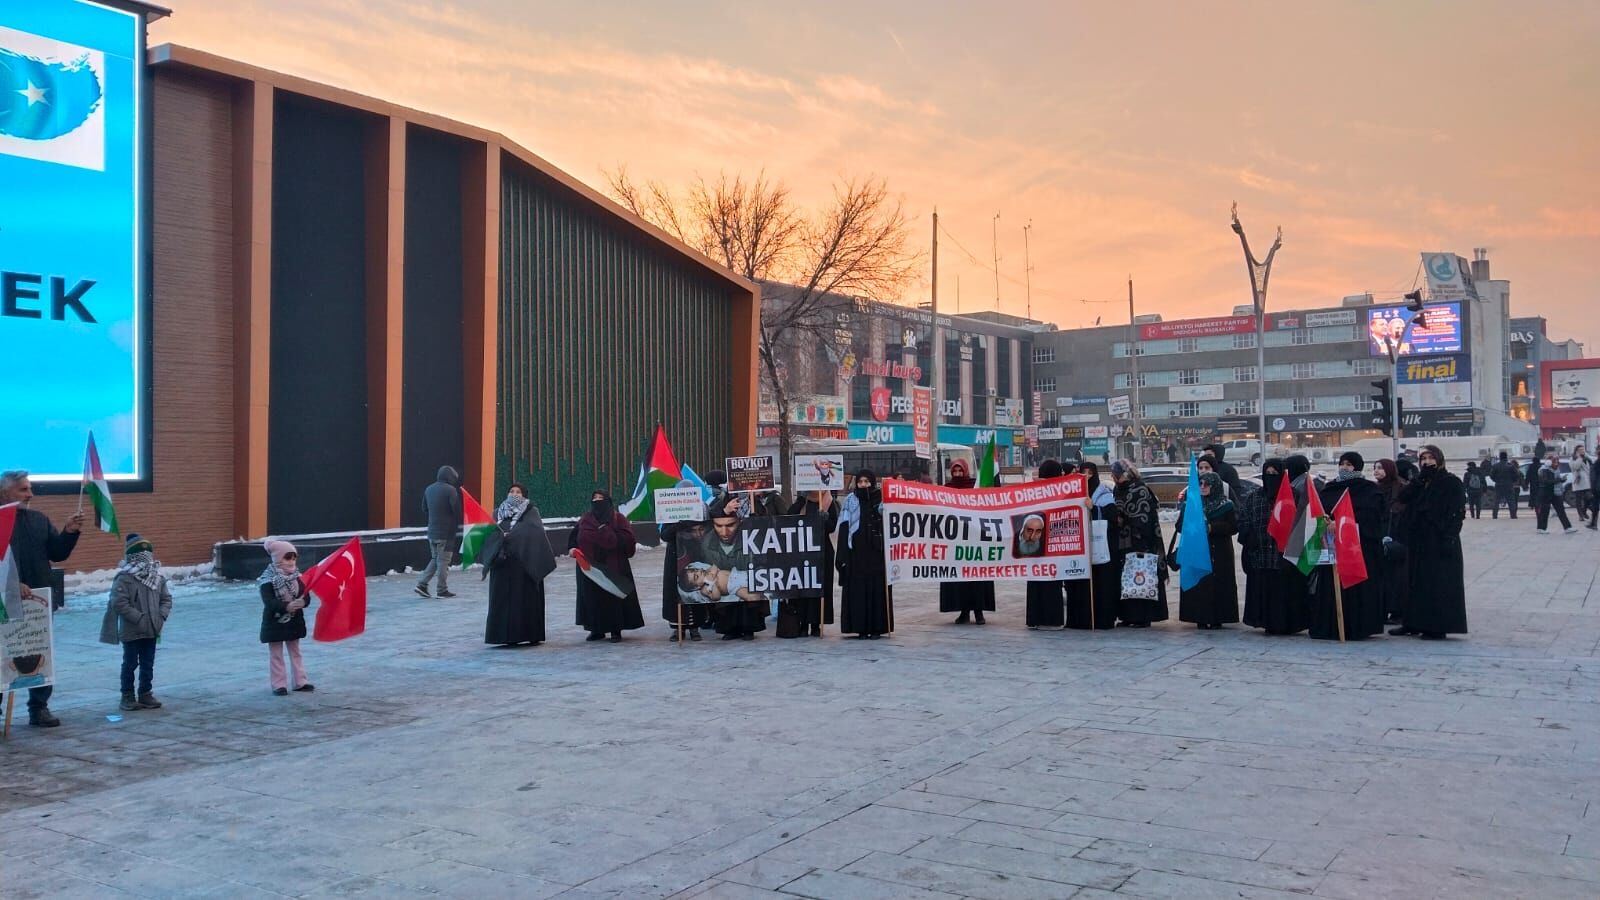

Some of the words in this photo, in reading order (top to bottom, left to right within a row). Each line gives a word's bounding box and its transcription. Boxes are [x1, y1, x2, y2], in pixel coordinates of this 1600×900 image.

[892, 359, 922, 380] kurs
[1407, 360, 1456, 380] final
[917, 415, 928, 430] 12
[1125, 425, 1160, 436] AYA
[1298, 417, 1355, 429] PRONOVA
[731, 458, 769, 469] BOYKOT
[888, 483, 933, 501] FİLİSTİN
[934, 490, 957, 505] İÇİN
[957, 490, 1014, 507] İNSANLIK
[1014, 478, 1083, 504] DİRENİYOR!
[889, 512, 972, 540] BOYKOT
[979, 518, 1003, 542] ET
[742, 520, 821, 555] KATİL
[890, 543, 926, 561] İNFAK
[931, 544, 948, 560] ET
[955, 545, 983, 561] DUA
[987, 546, 1005, 561] ET
[748, 560, 822, 592] İSRAİL
[912, 565, 958, 578] DURMA
[962, 565, 1028, 578] HAREKETE
[1031, 563, 1057, 579] GEÇ
